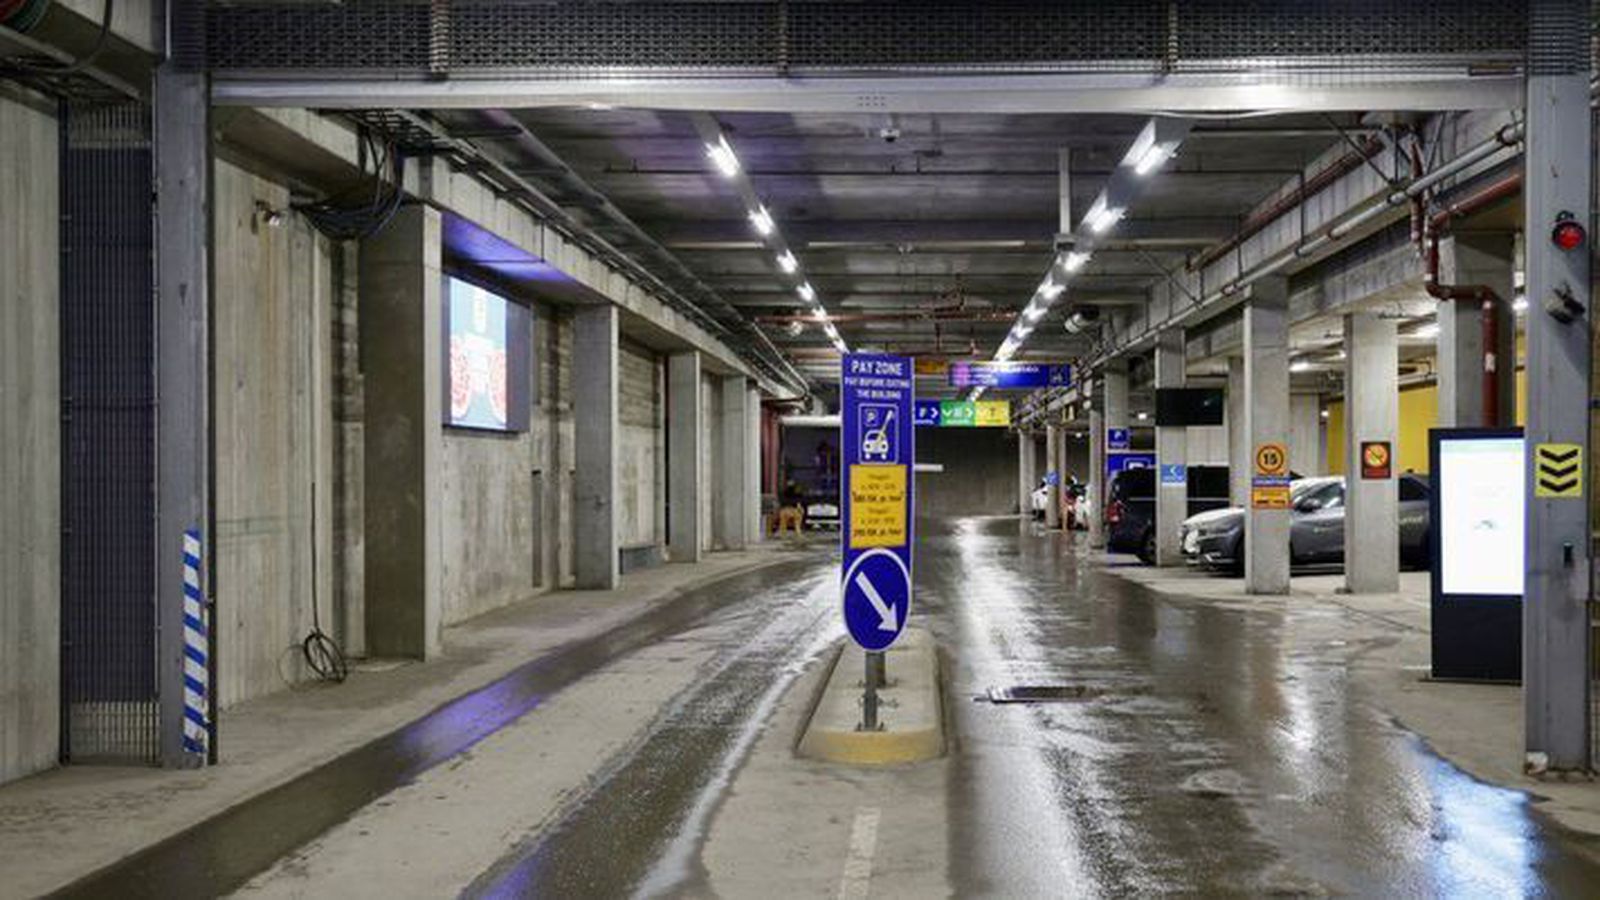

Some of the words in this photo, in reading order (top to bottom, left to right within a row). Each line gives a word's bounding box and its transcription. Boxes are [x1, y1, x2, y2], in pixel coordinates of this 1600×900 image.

[851, 360, 873, 374] PAY
[875, 361, 902, 376] ZONE
[1263, 453, 1278, 465] 15
